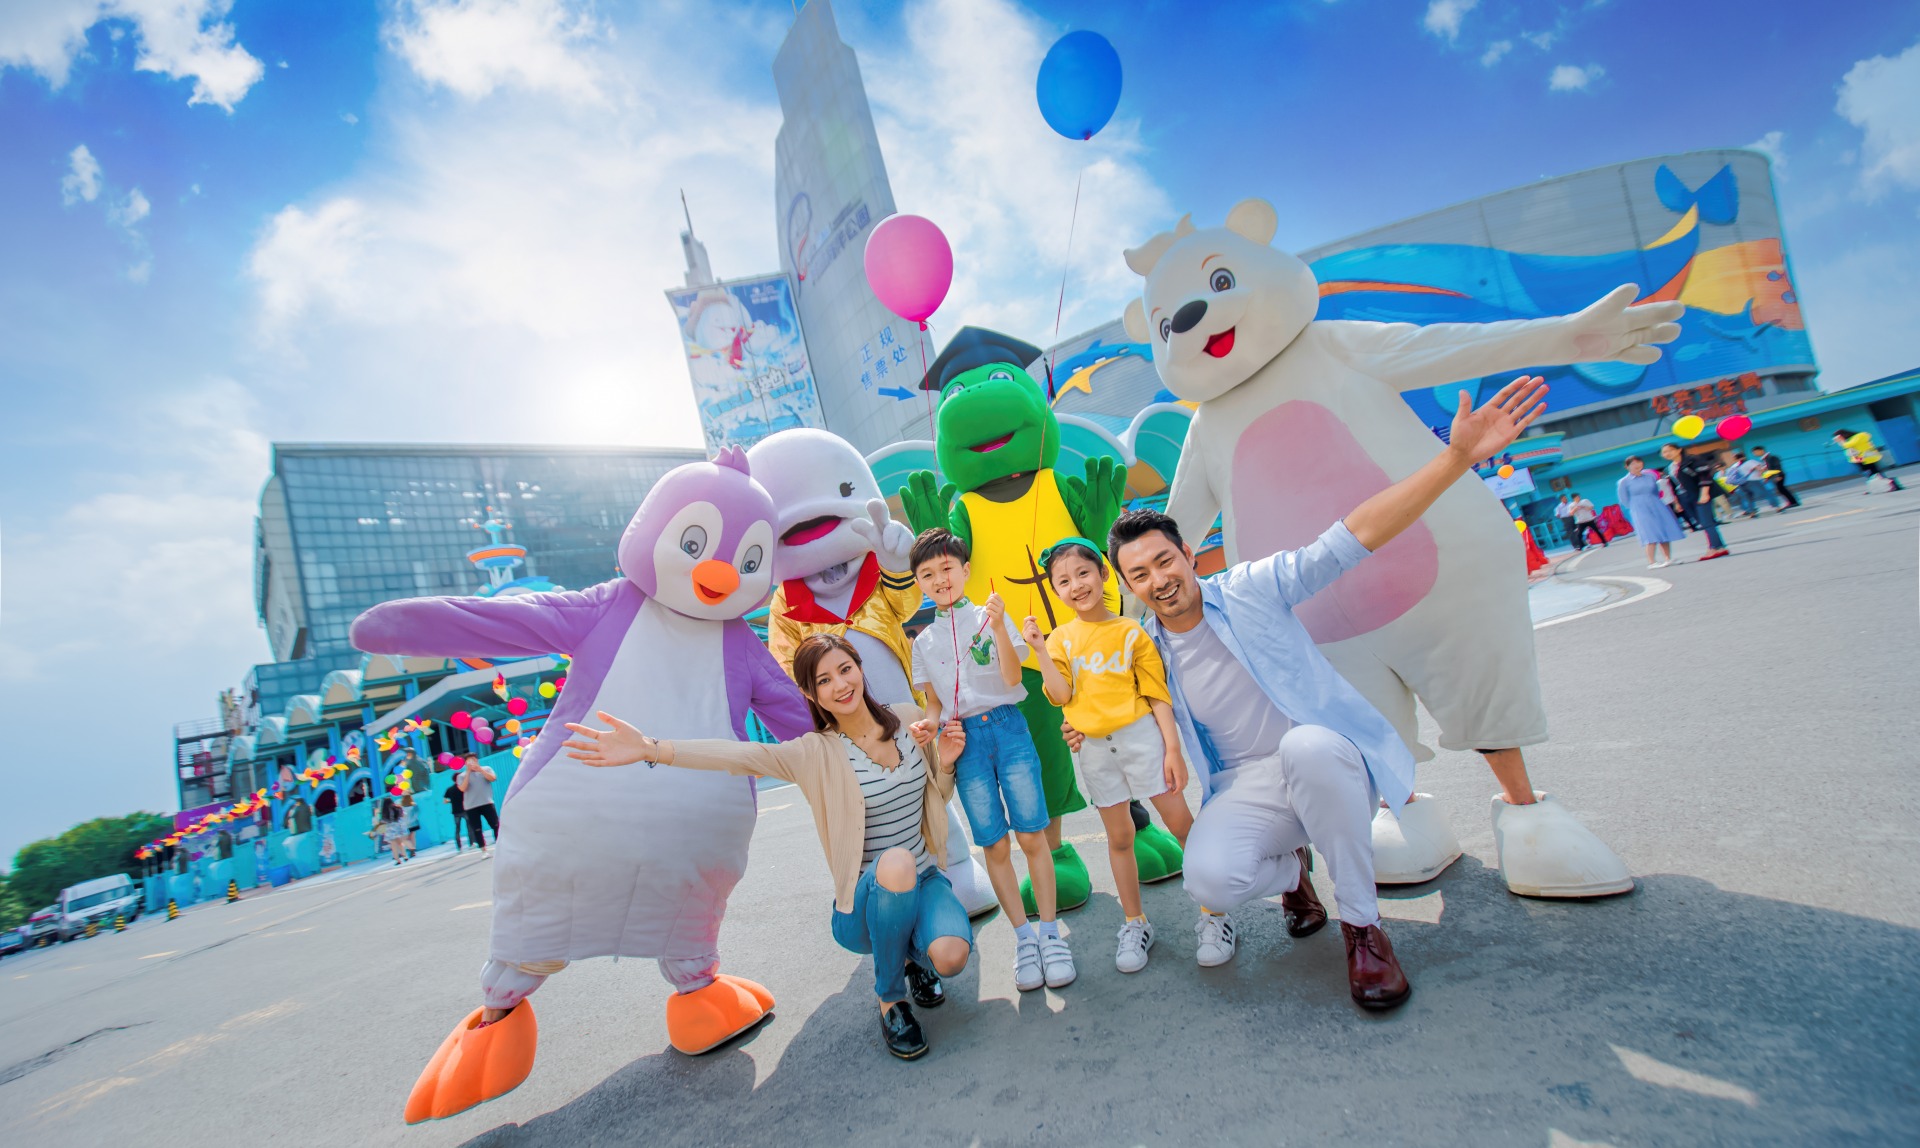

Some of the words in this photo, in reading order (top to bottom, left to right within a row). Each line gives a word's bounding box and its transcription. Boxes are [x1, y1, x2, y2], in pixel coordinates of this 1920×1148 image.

[860, 325, 894, 364] 正规
[861, 344, 907, 391] 售票处
[1651, 371, 1762, 414] 公共卫生间
